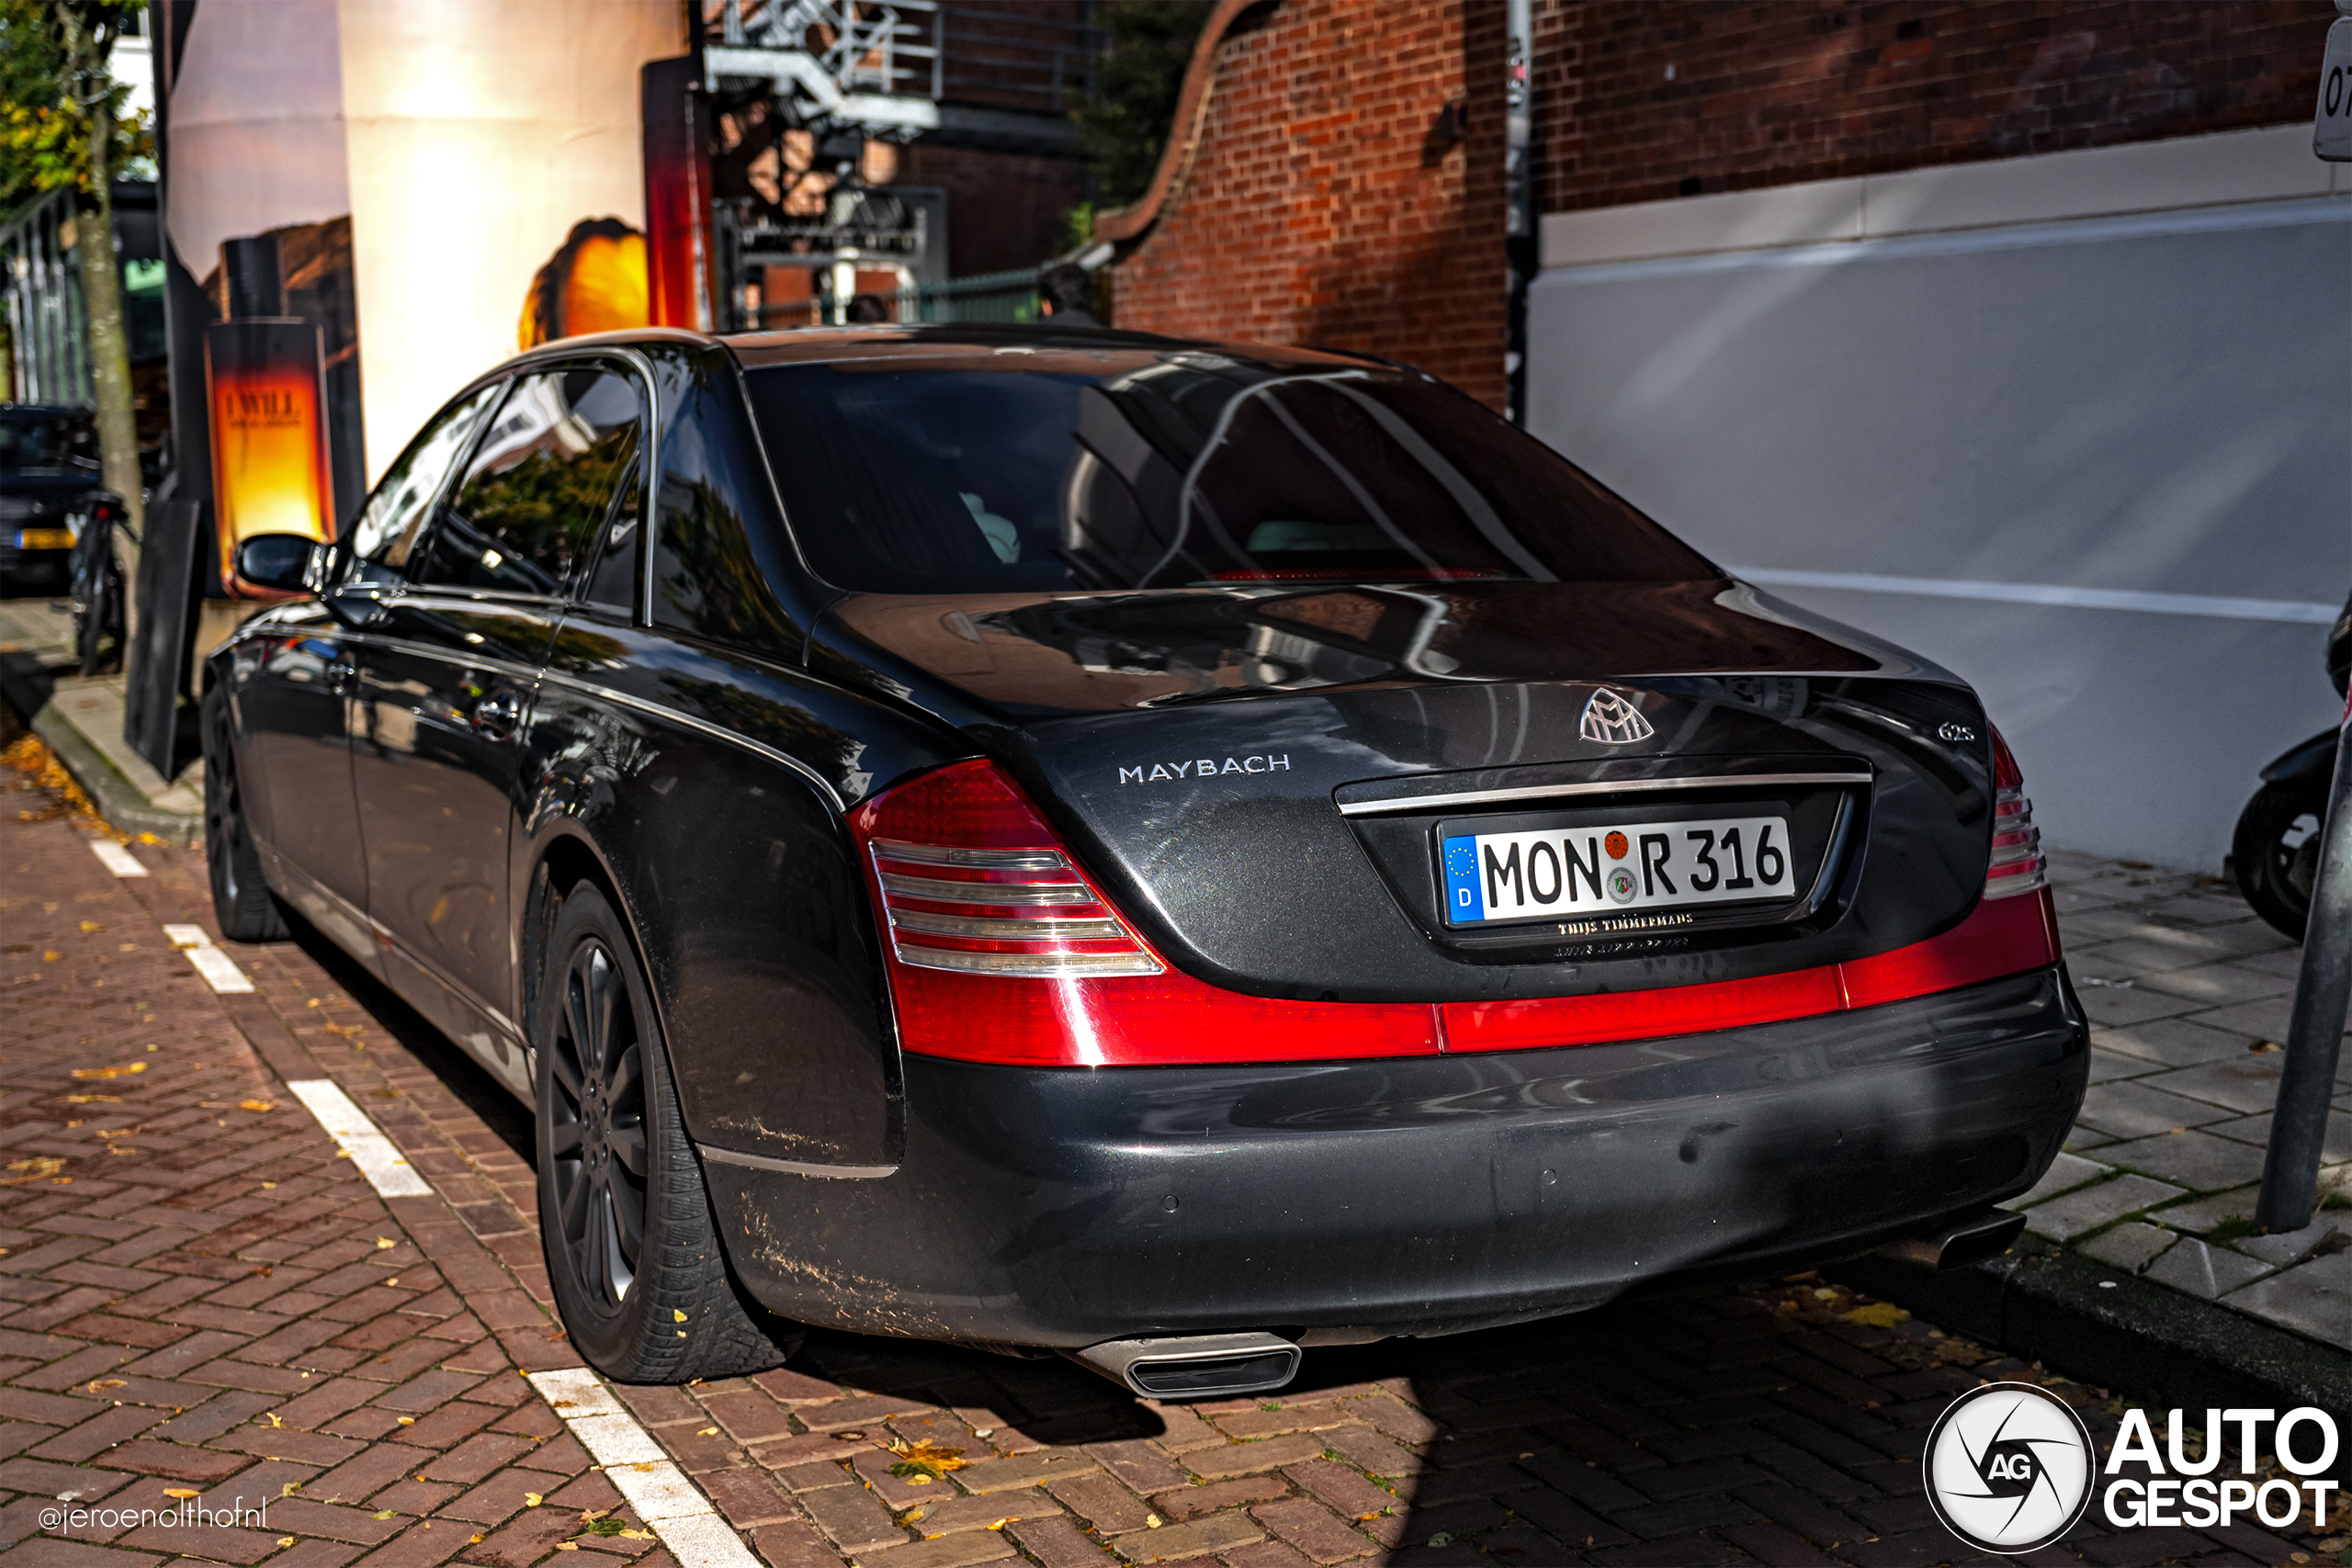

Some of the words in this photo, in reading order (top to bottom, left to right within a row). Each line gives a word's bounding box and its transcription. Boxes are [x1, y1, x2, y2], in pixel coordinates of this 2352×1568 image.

[1118, 754, 1291, 784] MAYBACH
[1484, 837, 1603, 908] MON
[1639, 833, 1678, 897] R
[1686, 825, 1784, 892] 316
[1458, 887, 1472, 908] D
[1558, 921, 1598, 936] THIJS
[1602, 913, 1694, 931] TIMMERMANS
